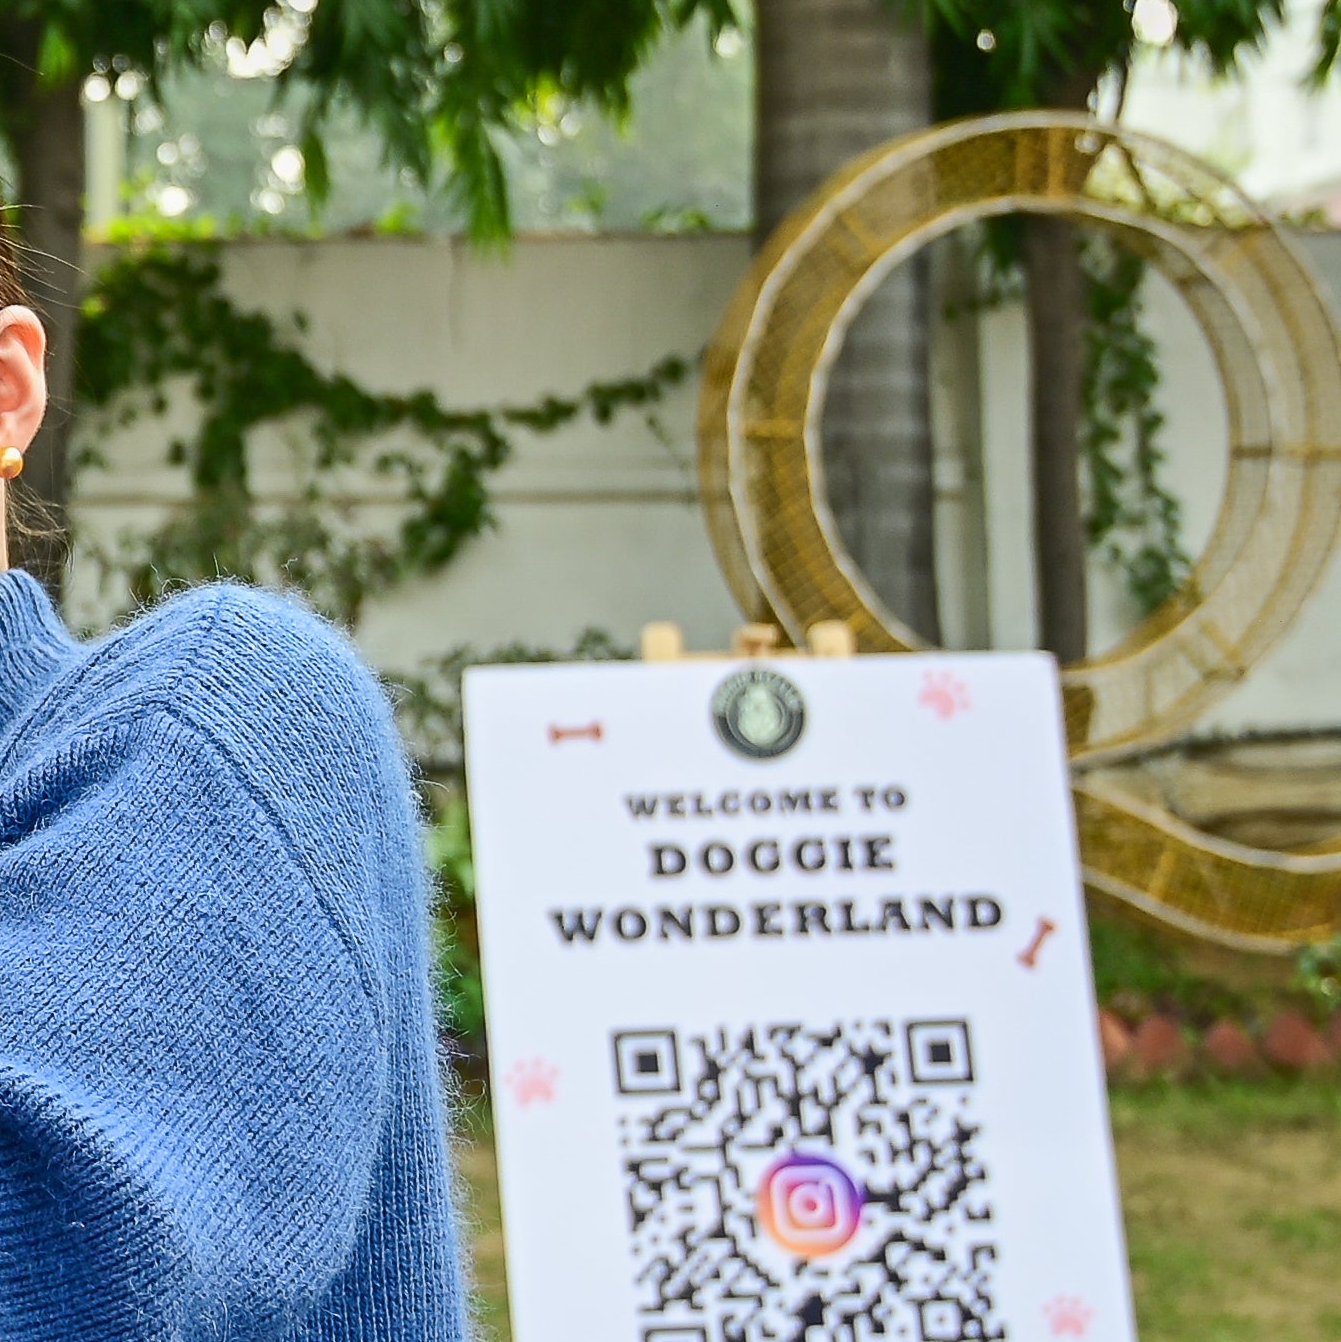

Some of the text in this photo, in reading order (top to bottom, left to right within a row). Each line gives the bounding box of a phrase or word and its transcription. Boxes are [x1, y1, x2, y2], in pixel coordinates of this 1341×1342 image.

[624, 785, 908, 819] WELCOME TO
[649, 836, 896, 877] DOGGIE
[550, 896, 1003, 944] WONDERLAND
